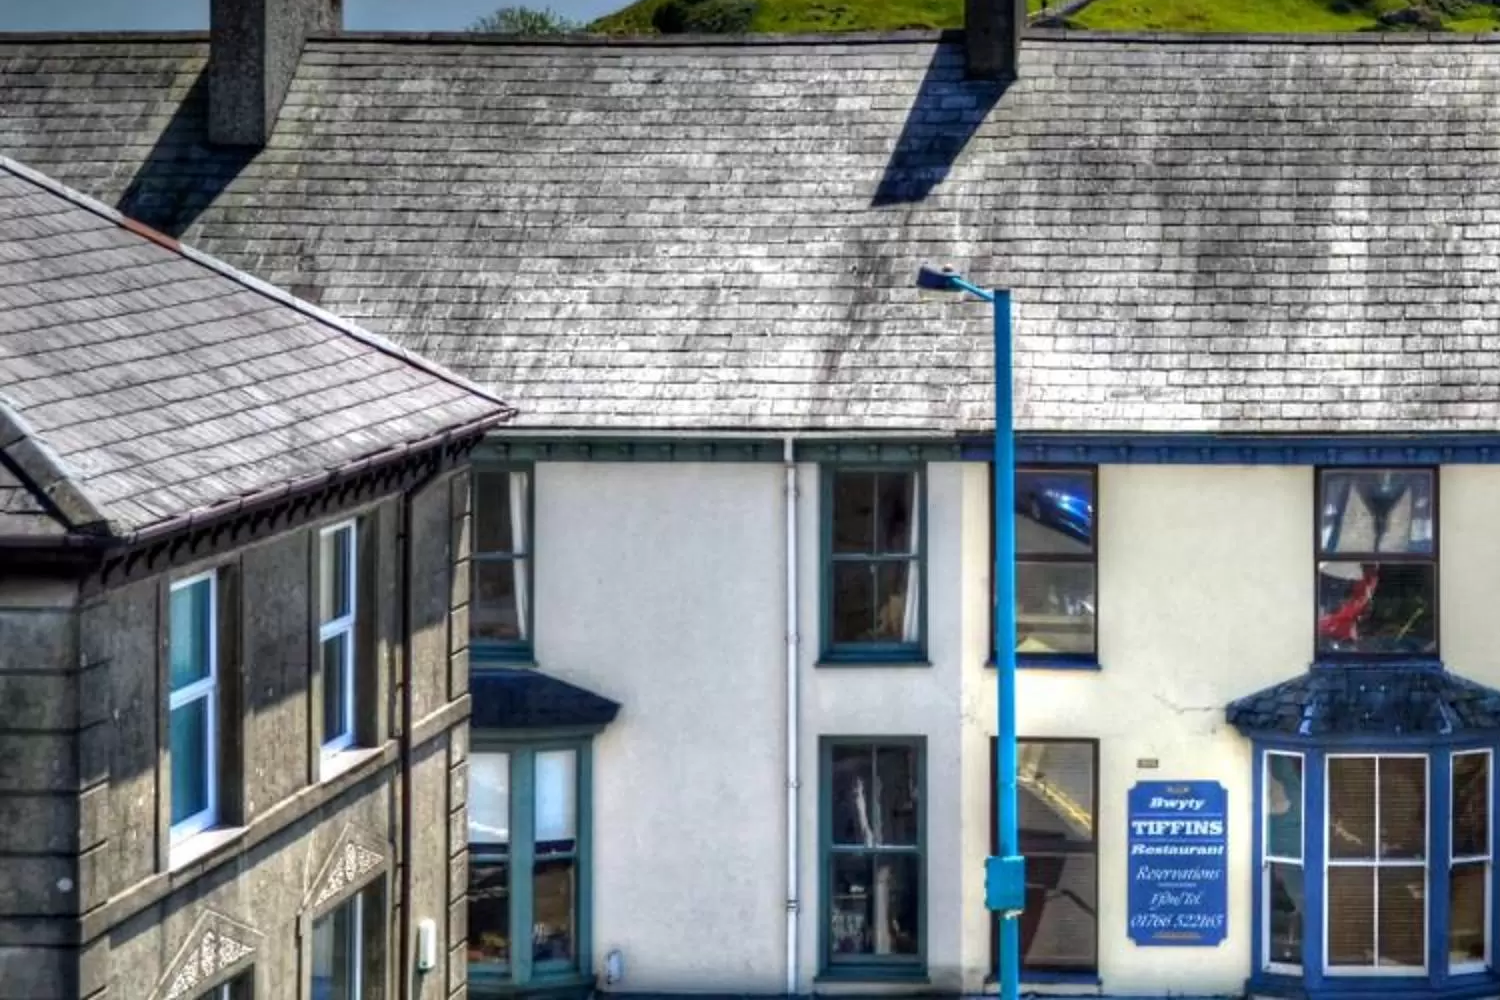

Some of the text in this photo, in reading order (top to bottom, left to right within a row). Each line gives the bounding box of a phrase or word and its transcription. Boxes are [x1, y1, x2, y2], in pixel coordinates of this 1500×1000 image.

[1148, 796, 1206, 811] Bwyty
[1131, 820, 1224, 836] TIFFINS
[1131, 843, 1225, 856] Restaurant
